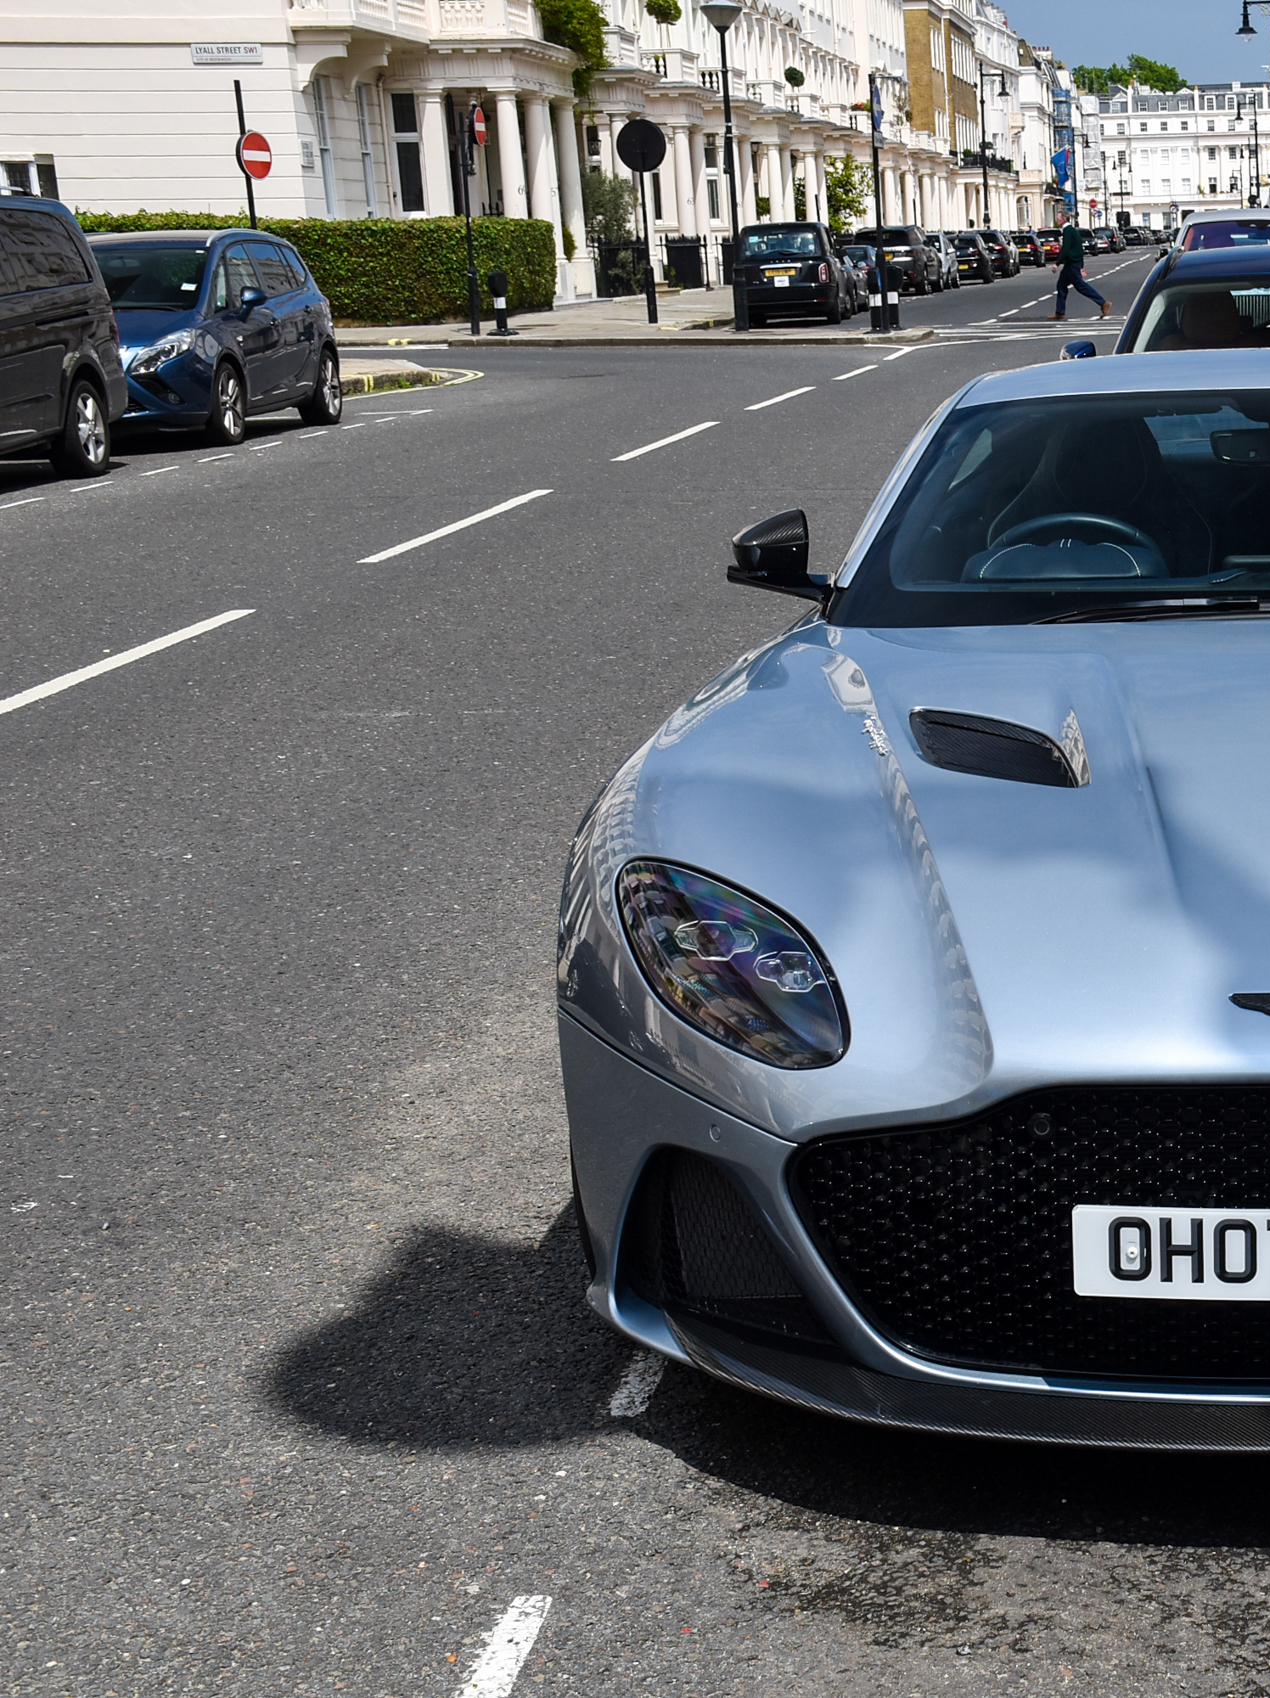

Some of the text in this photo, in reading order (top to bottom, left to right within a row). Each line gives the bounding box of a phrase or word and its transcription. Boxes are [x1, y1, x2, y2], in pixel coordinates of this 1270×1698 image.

[195, 46, 258, 55] LYALL STREET SW1
